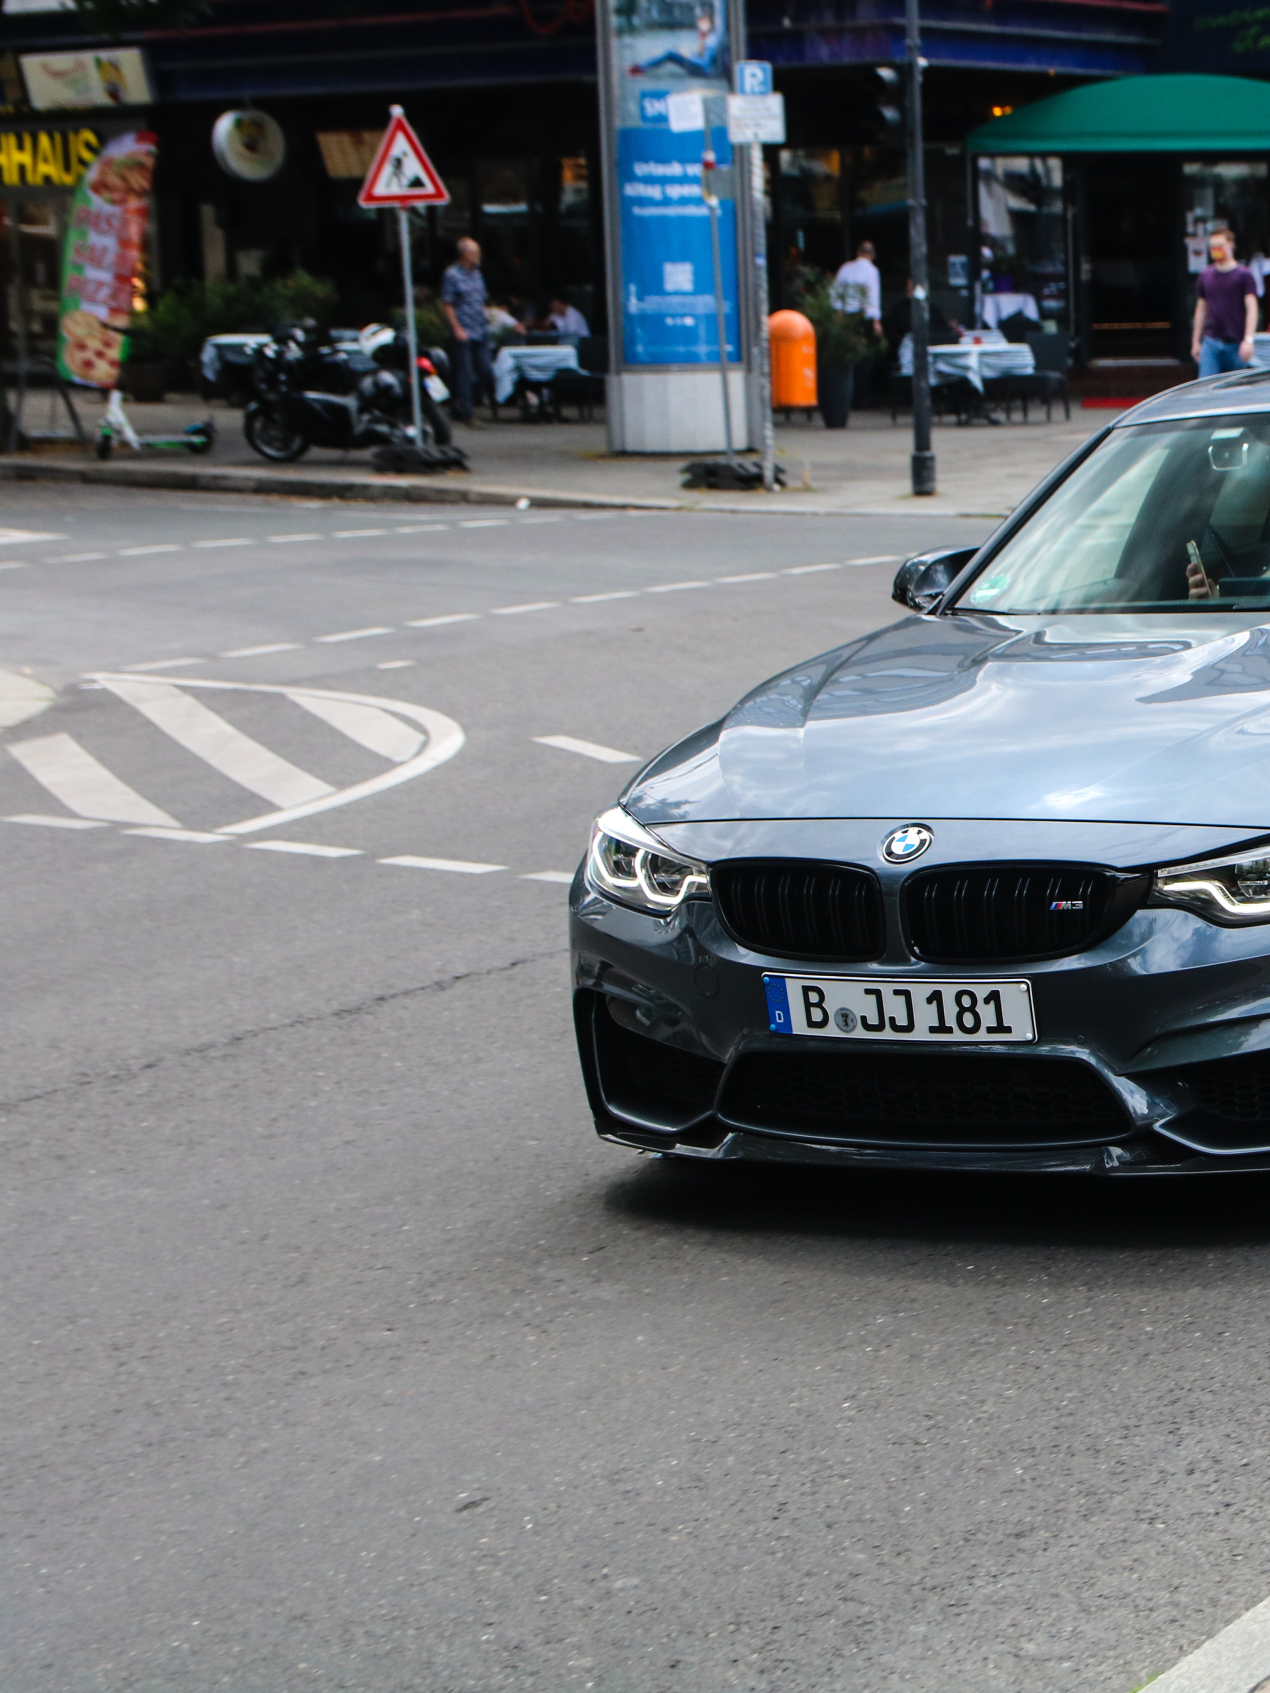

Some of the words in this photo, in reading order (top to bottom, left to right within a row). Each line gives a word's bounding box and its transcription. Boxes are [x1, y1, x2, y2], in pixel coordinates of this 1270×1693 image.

[775, 1010, 784, 1023] D
[801, 985, 829, 1029] B
[860, 987, 915, 1032] JJ
[926, 989, 1012, 1034] 181
